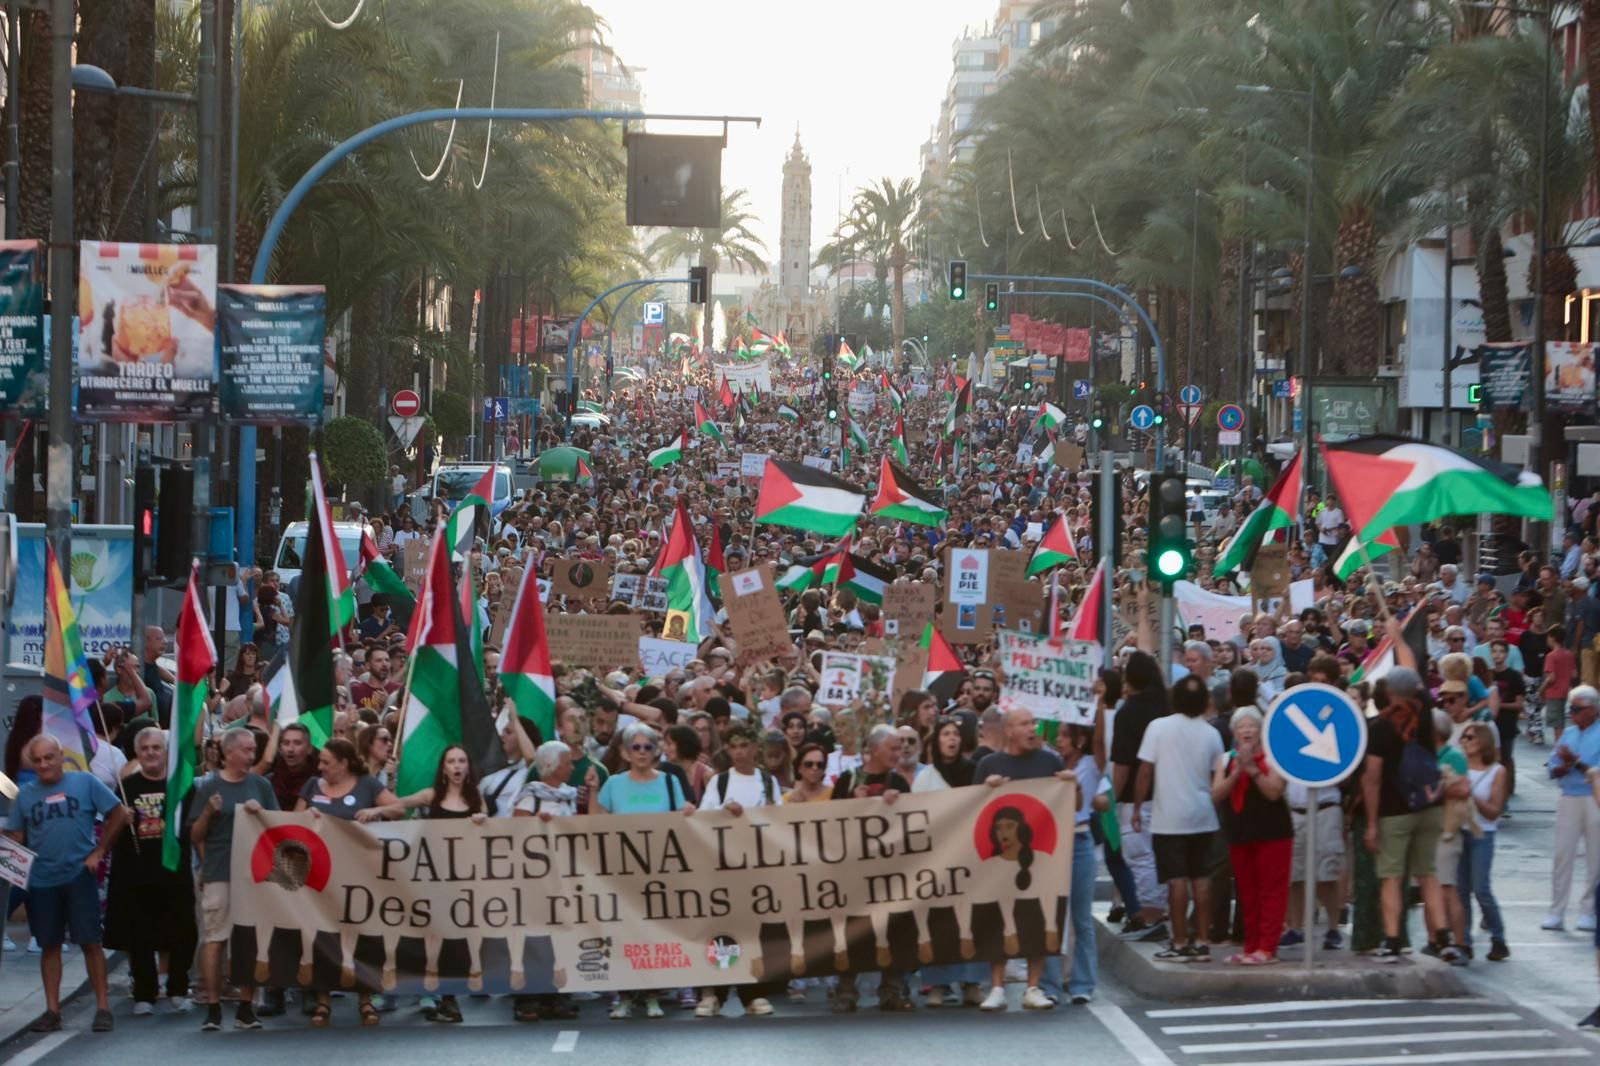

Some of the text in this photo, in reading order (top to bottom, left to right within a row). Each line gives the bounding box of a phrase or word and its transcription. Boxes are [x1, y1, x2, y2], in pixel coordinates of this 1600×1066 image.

[5, 338, 28, 350] FEST
[119, 361, 174, 379] TARDEO
[80, 376, 210, 392] ATARDECERES EL MUELLE
[960, 571, 978, 581] EN
[958, 581, 979, 590] PIE
[1127, 600, 1156, 616] FRE
[31, 795, 80, 827] GAP
[375, 809, 933, 883] PALESTINA LLIURE
[339, 865, 972, 928] Des del riu fins a la mar
[624, 943, 650, 957] BDS
